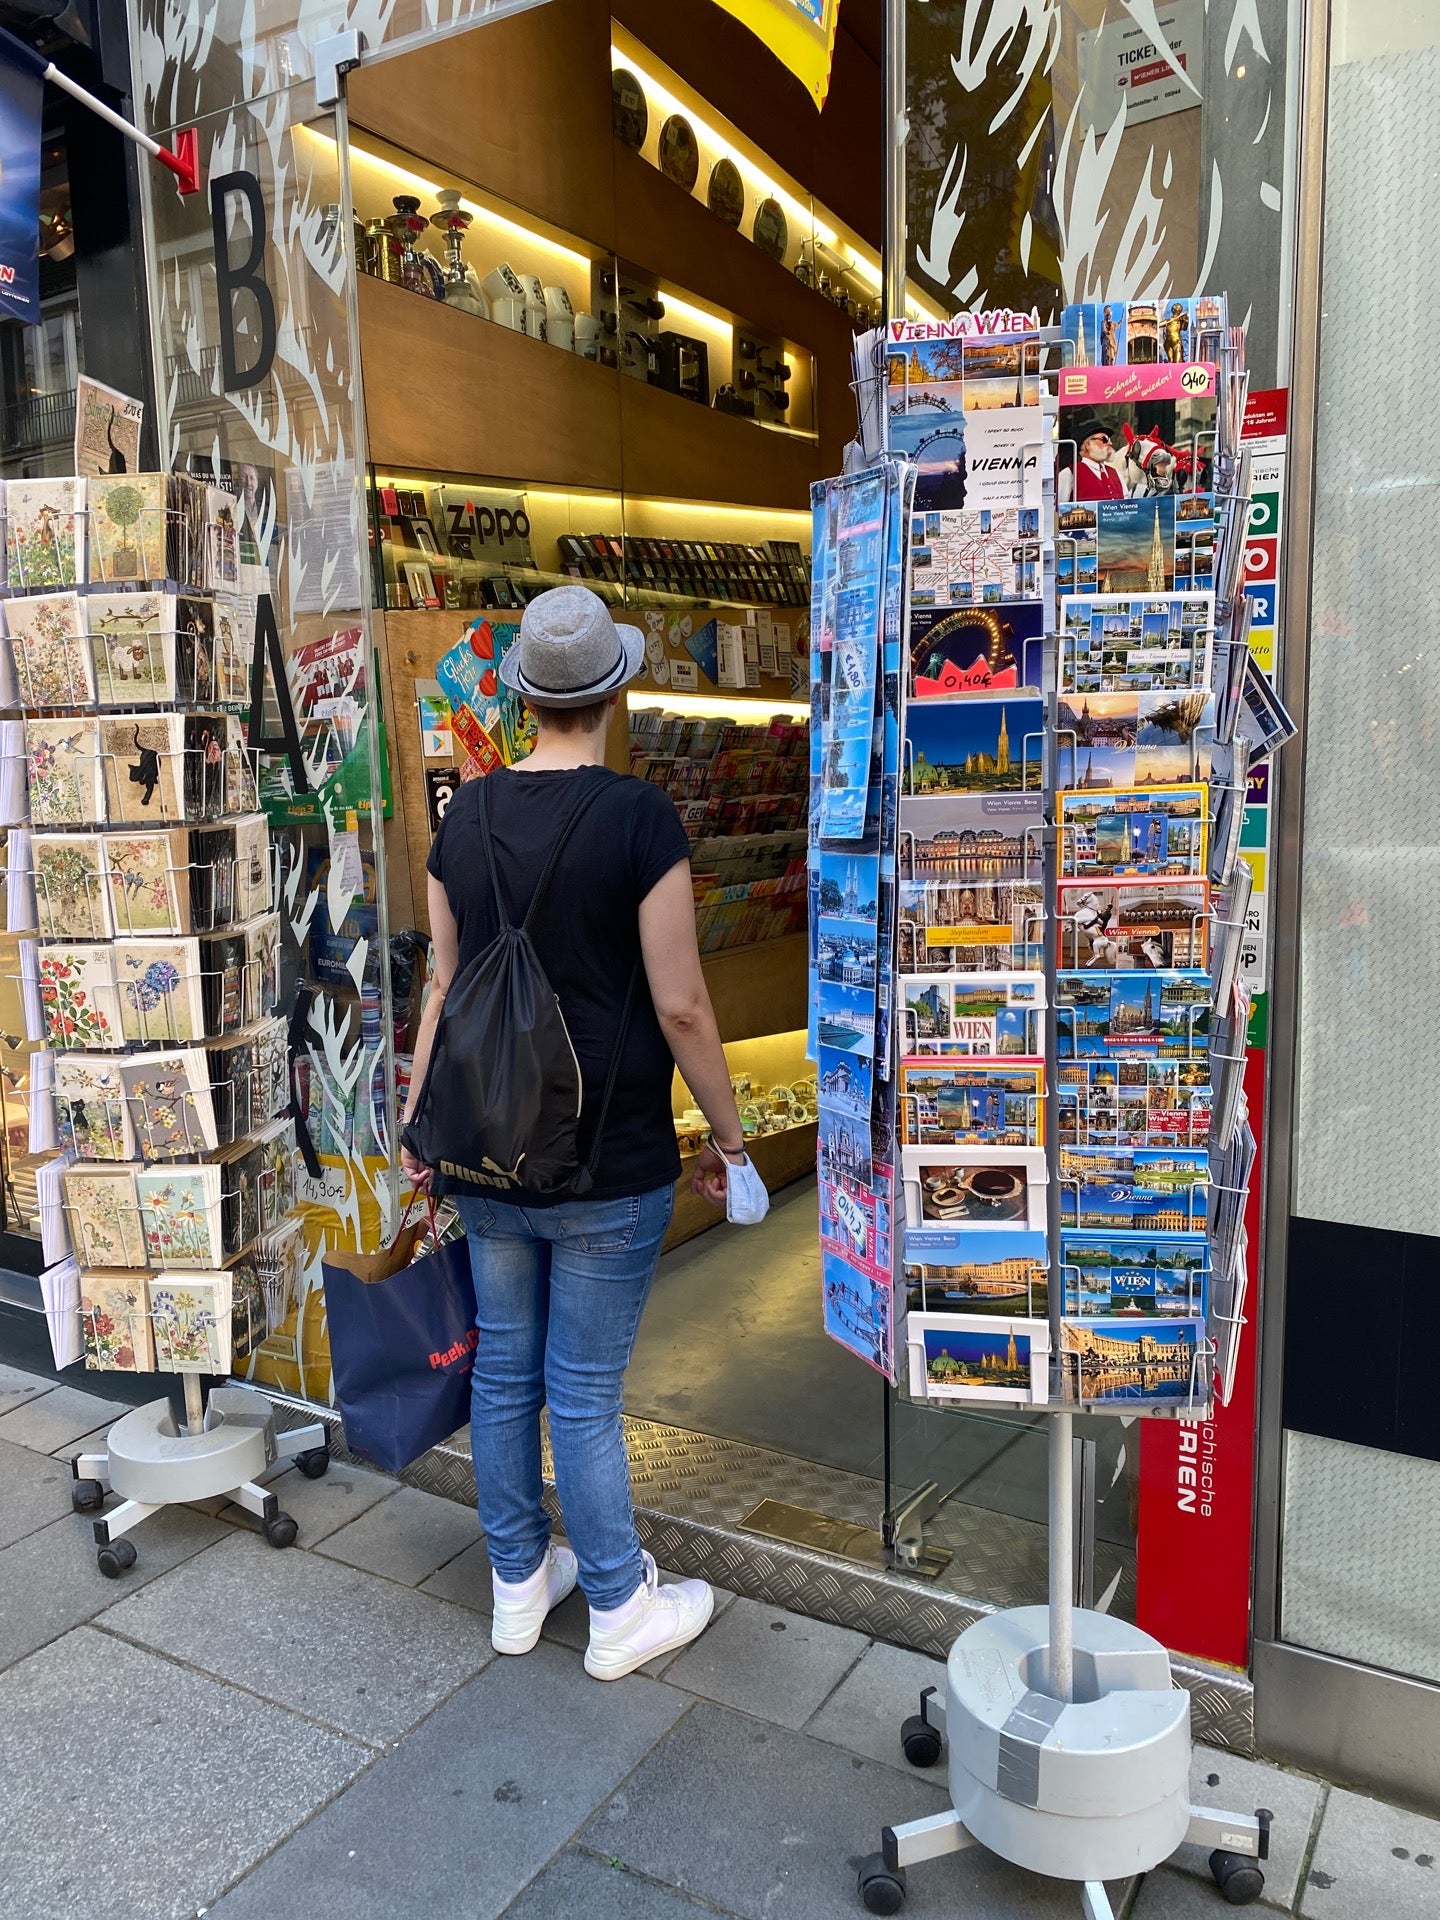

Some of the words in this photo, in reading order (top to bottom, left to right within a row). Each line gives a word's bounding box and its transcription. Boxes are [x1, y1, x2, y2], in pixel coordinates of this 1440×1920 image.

[1117, 44, 1157, 66] TICKET
[0, 264, 15, 284] N
[890, 320, 968, 342] VIENNA
[974, 311, 1038, 334] WIEN
[1104, 371, 1138, 399] Schreib
[1124, 380, 1143, 398] mal
[1141, 369, 1173, 397] wieder!
[972, 456, 1037, 472] VIENNA
[944, 672, 991, 689] 0,40€
[1112, 739, 1158, 754] Vienna
[953, 1021, 993, 1040] WIEN
[440, 1159, 511, 1190] PUMA
[302, 1178, 345, 1200] 14,90€
[1108, 1189, 1153, 1203] Vienna
[1113, 1275, 1151, 1286] WIEN
